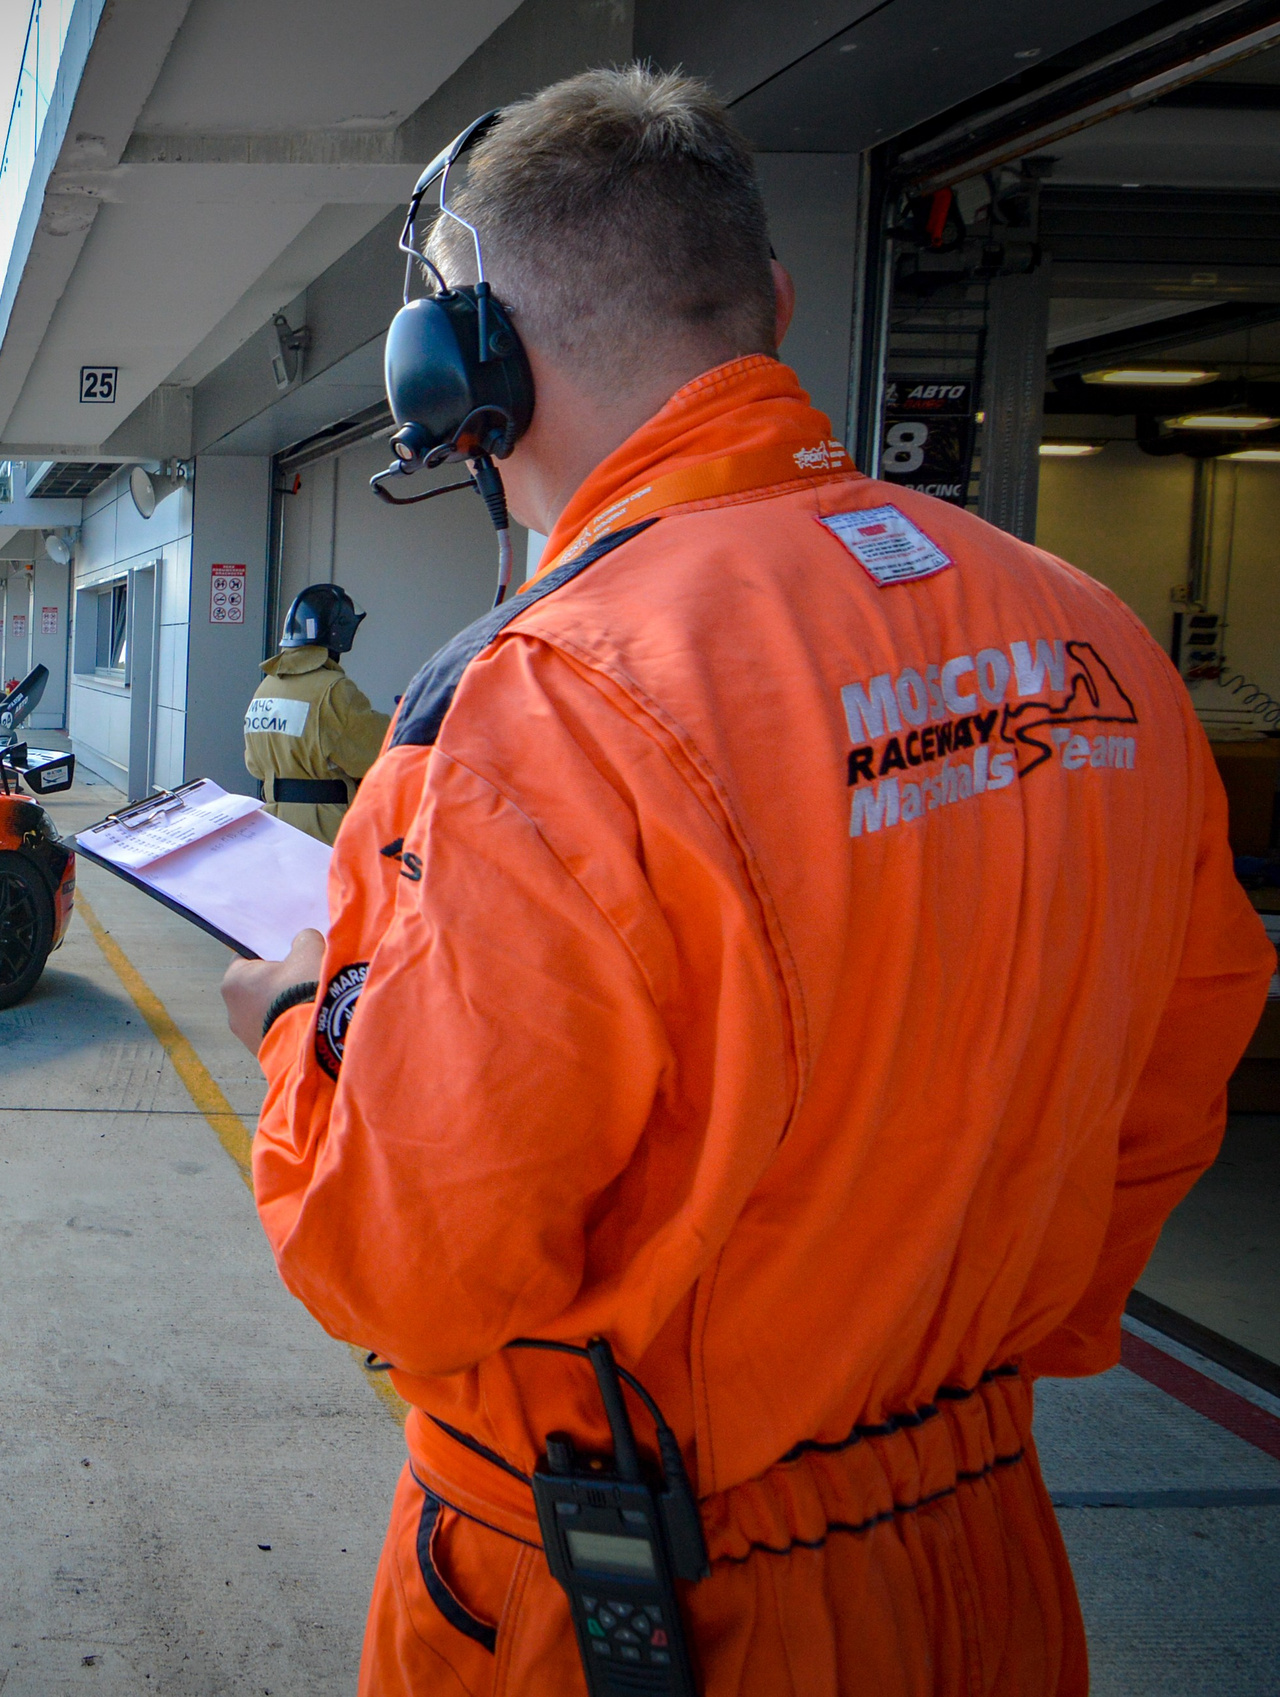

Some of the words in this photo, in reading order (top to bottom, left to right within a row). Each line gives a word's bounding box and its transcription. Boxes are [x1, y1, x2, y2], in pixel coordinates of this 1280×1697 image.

[84, 372, 113, 399] 25
[908, 385, 966, 399] АВТО
[882, 421, 929, 474] 8
[841, 640, 1065, 745] MOSCOW
[847, 710, 998, 786] RACEWAY
[849, 744, 1017, 838] Marshals
[1051, 728, 1136, 770] Team
